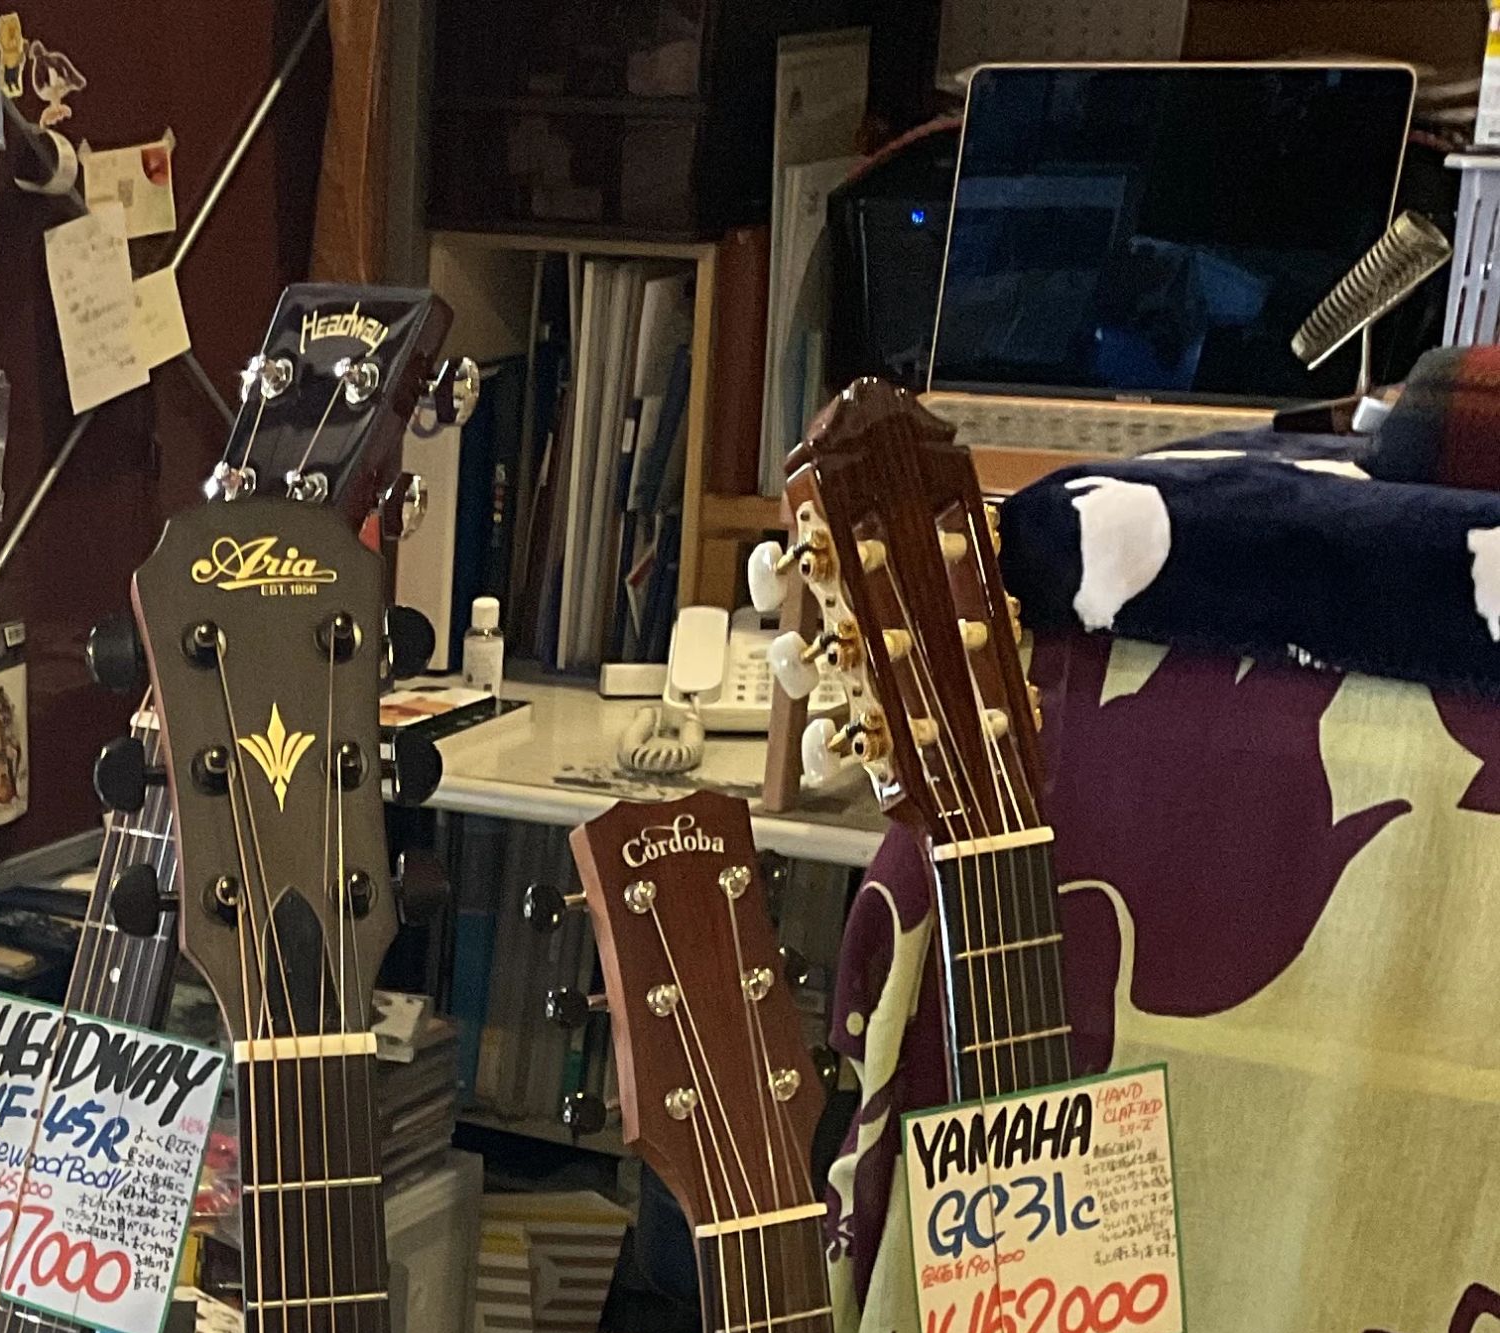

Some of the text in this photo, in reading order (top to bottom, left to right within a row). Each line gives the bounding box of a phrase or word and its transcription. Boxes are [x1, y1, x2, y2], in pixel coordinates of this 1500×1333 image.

[300, 301, 389, 357] Headway
[192, 536, 338, 591] Aria
[912, 1092, 1093, 1190] YAMAHA
